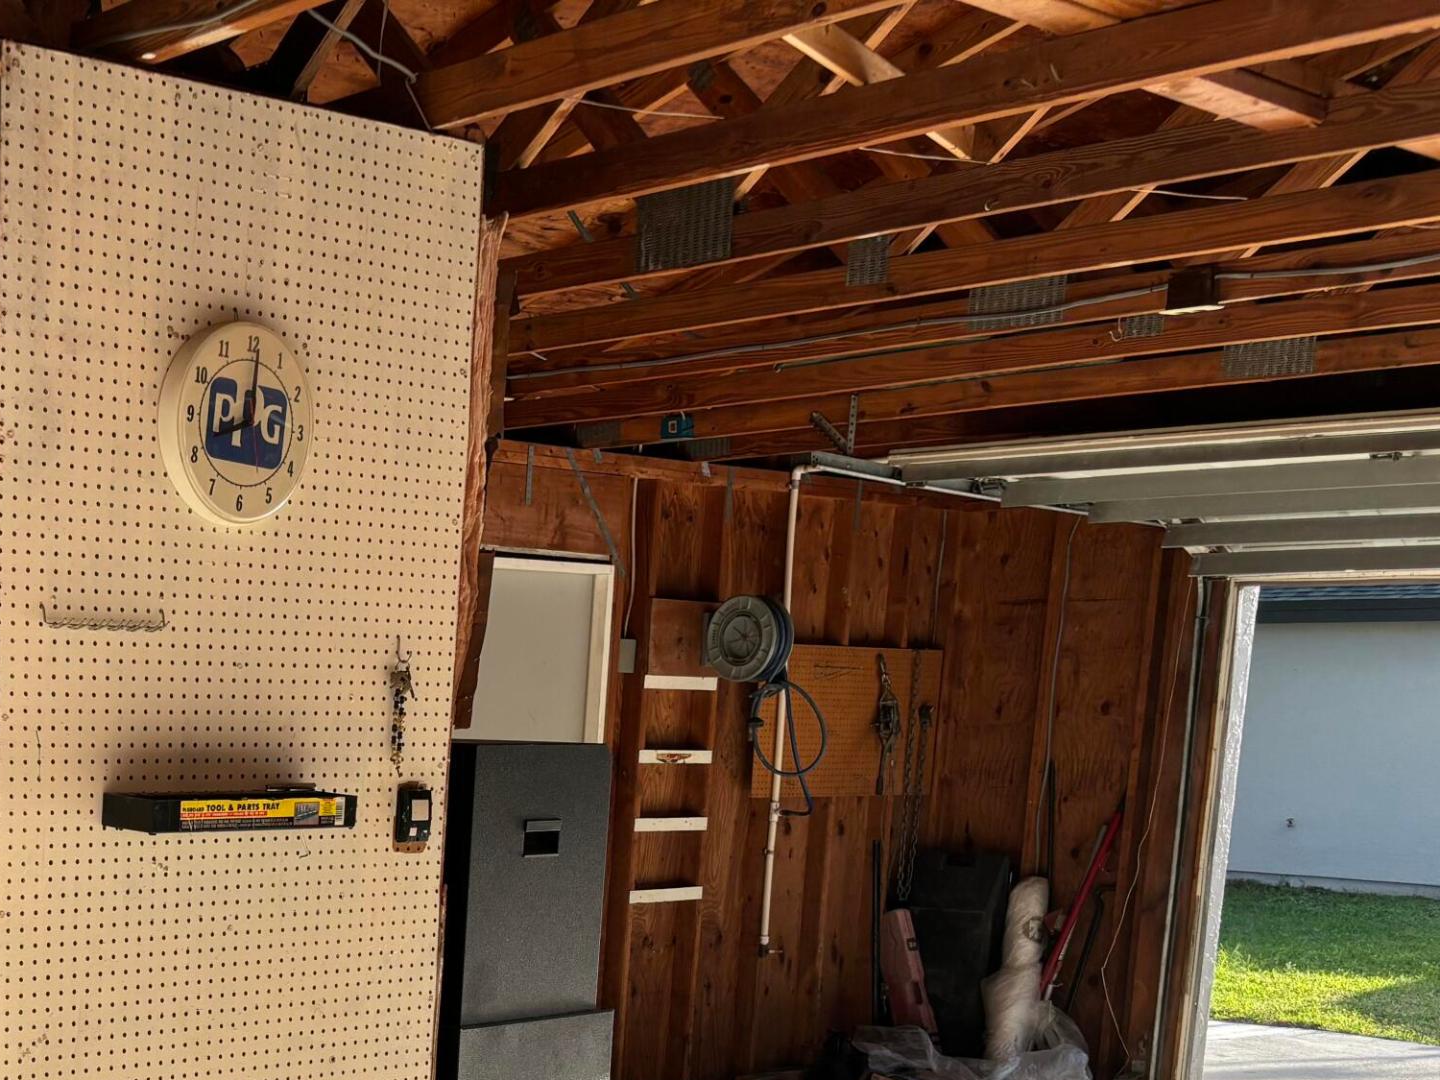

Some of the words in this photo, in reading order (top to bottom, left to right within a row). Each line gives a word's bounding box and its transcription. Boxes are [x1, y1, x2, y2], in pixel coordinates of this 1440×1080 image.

[218, 340, 230, 358] 11
[247, 336, 260, 352] 12
[277, 352, 283, 369] 1
[195, 366, 207, 384] 10
[294, 386, 301, 402] 2
[186, 405, 194, 422] 9
[212, 383, 283, 448] PPG
[297, 426, 304, 441] 3
[190, 446, 198, 463] 8
[287, 461, 294, 477] 4
[209, 479, 216, 496] 7
[265, 488, 272, 504] 5
[236, 495, 243, 512] 6
[206, 804, 225, 812] TOOL
[237, 803, 259, 811] PARTS
[262, 802, 280, 810] TRAY
